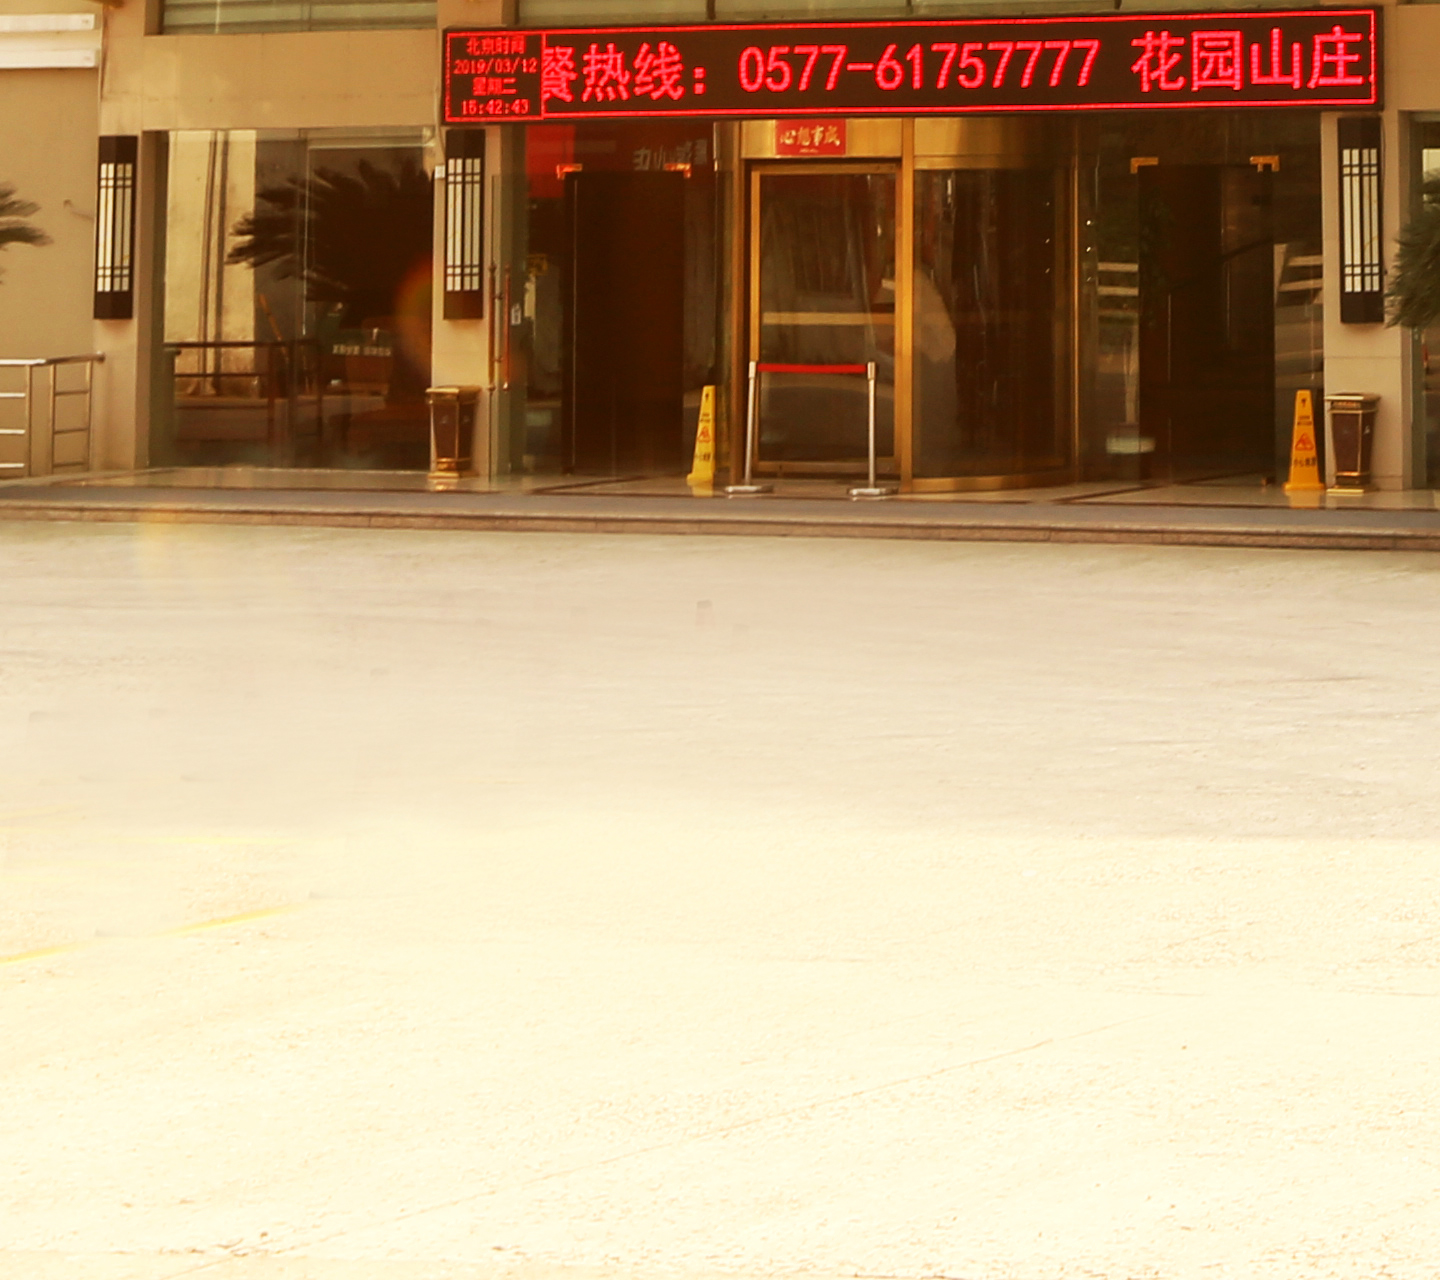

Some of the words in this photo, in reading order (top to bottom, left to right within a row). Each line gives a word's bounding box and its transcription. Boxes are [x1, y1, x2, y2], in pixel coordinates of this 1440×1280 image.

[453, 57, 539, 75] 2019/03/12
[738, 39, 1100, 93] 0577-61757777
[1131, 25, 1364, 93] 花园山庄
